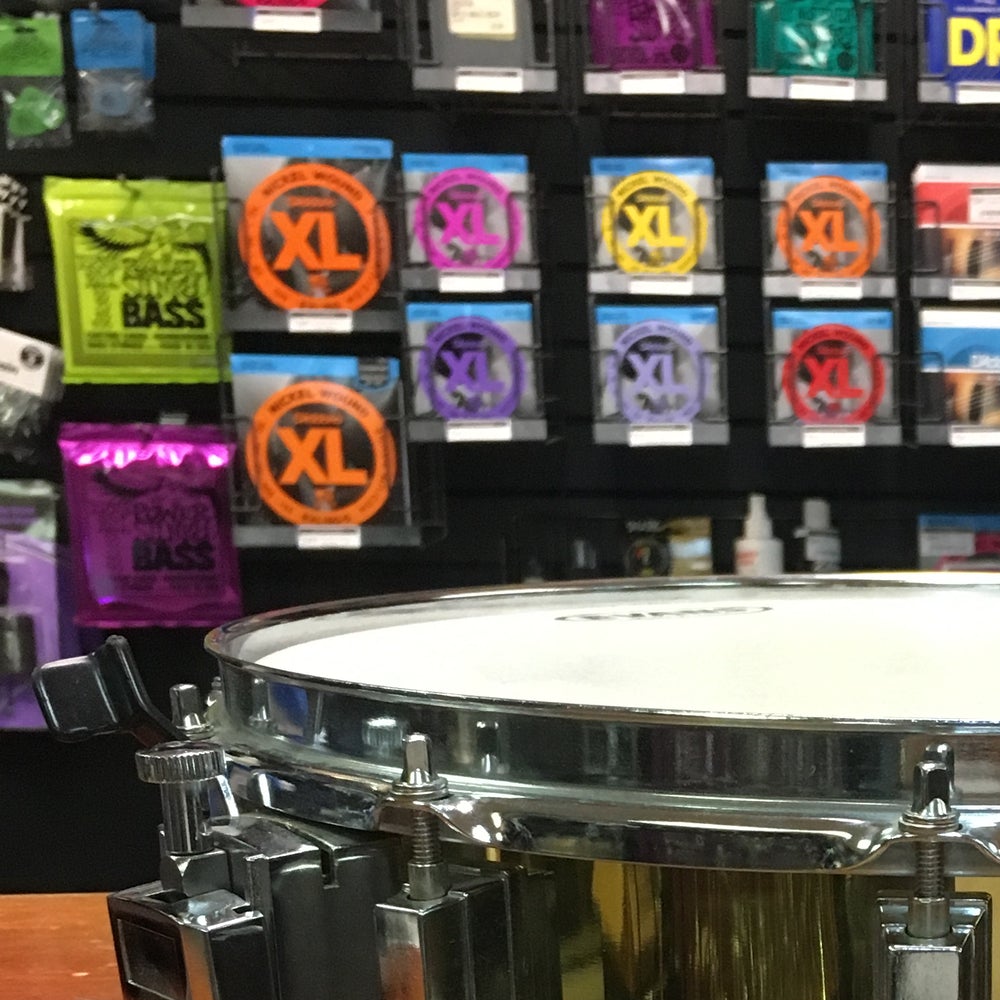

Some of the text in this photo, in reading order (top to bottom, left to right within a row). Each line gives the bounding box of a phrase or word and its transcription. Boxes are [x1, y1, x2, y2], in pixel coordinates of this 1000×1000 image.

[270, 210, 363, 271] XL
[437, 201, 500, 245] XL
[624, 204, 687, 248] XL
[800, 209, 859, 252] XL
[121, 293, 206, 328] BASS
[441, 350, 506, 393] XL
[627, 353, 689, 395] XL
[804, 357, 865, 399] XL
[276, 425, 369, 486] XL
[132, 537, 217, 571] BASS
